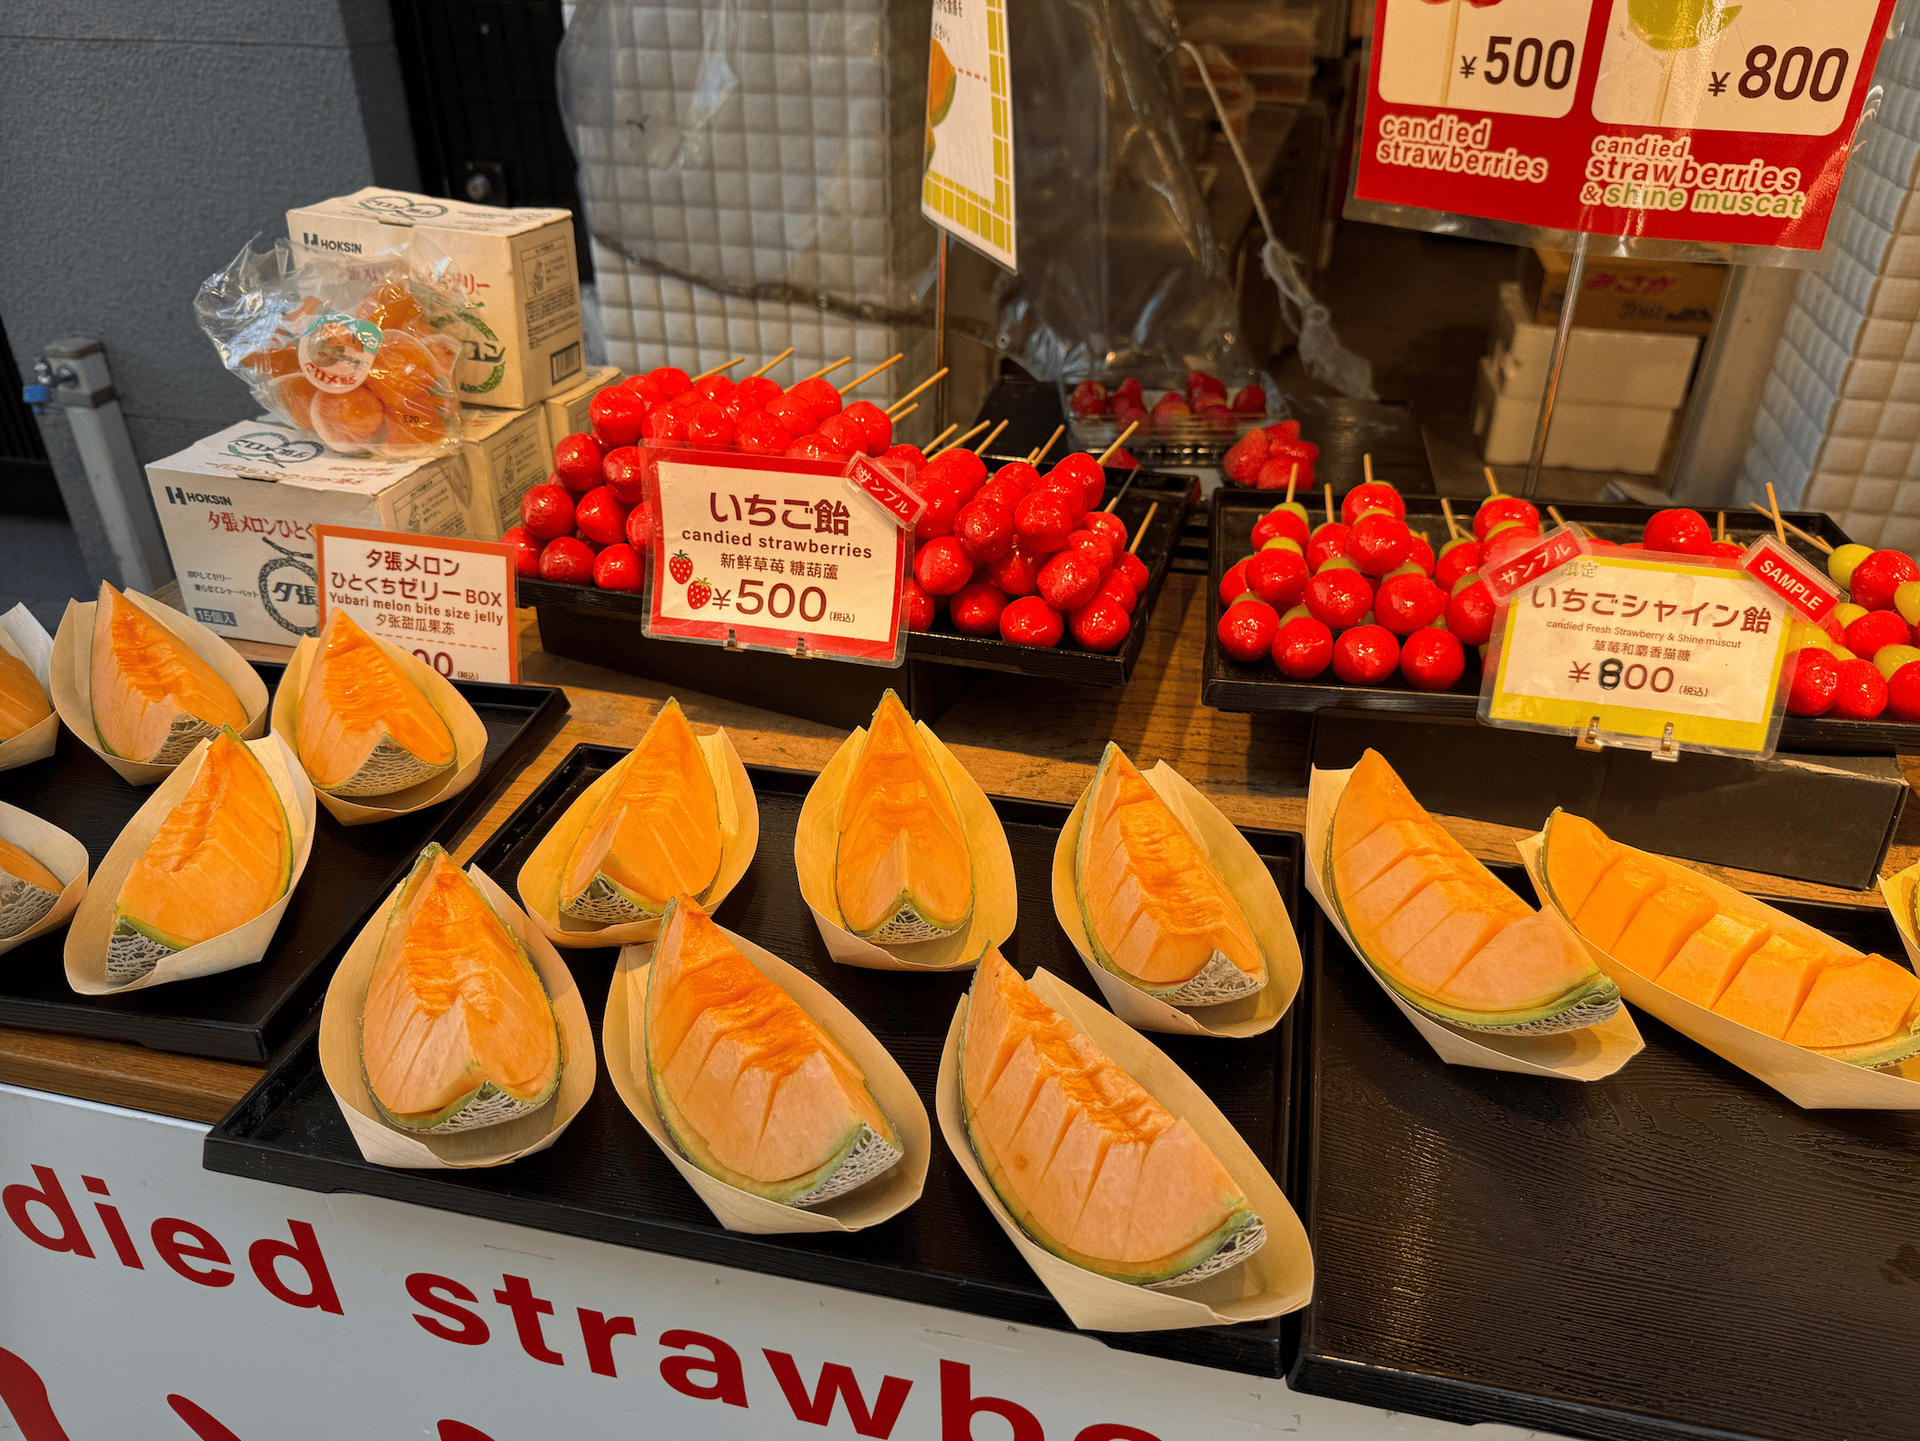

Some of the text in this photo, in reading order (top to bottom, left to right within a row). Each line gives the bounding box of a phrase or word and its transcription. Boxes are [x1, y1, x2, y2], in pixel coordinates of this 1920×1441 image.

[1460, 36, 1576, 91] ¥500
[1707, 45, 1849, 102] ¥800
[1381, 116, 1490, 147] candied
[1593, 137, 1689, 159] candied
[1377, 140, 1547, 181] strawberries
[1588, 156, 1800, 190] strawberries
[1583, 182, 1803, 216] & shine muscat
[860, 468, 909, 514] サンプル
[709, 492, 851, 537] いちご飴
[366, 549, 460, 577] 夕張メロン
[681, 528, 873, 559] candied strawberries
[1501, 543, 1571, 585] サンプル
[711, 578, 828, 623] ¥500
[1759, 560, 1823, 611] SAMPLE
[329, 591, 503, 626] Yubari melon bite size jelly
[1530, 584, 1773, 635] いちごシャイン飴
[1546, 620, 1583, 632] candied
[1586, 623, 1611, 634] Fresh
[1613, 626, 1664, 642] Strawberry
[1667, 632, 1675, 641] &
[1677, 633, 1703, 645] Shine
[1567, 657, 1674, 693] ¥800
[404, 1273, 1164, 1441] strawb
